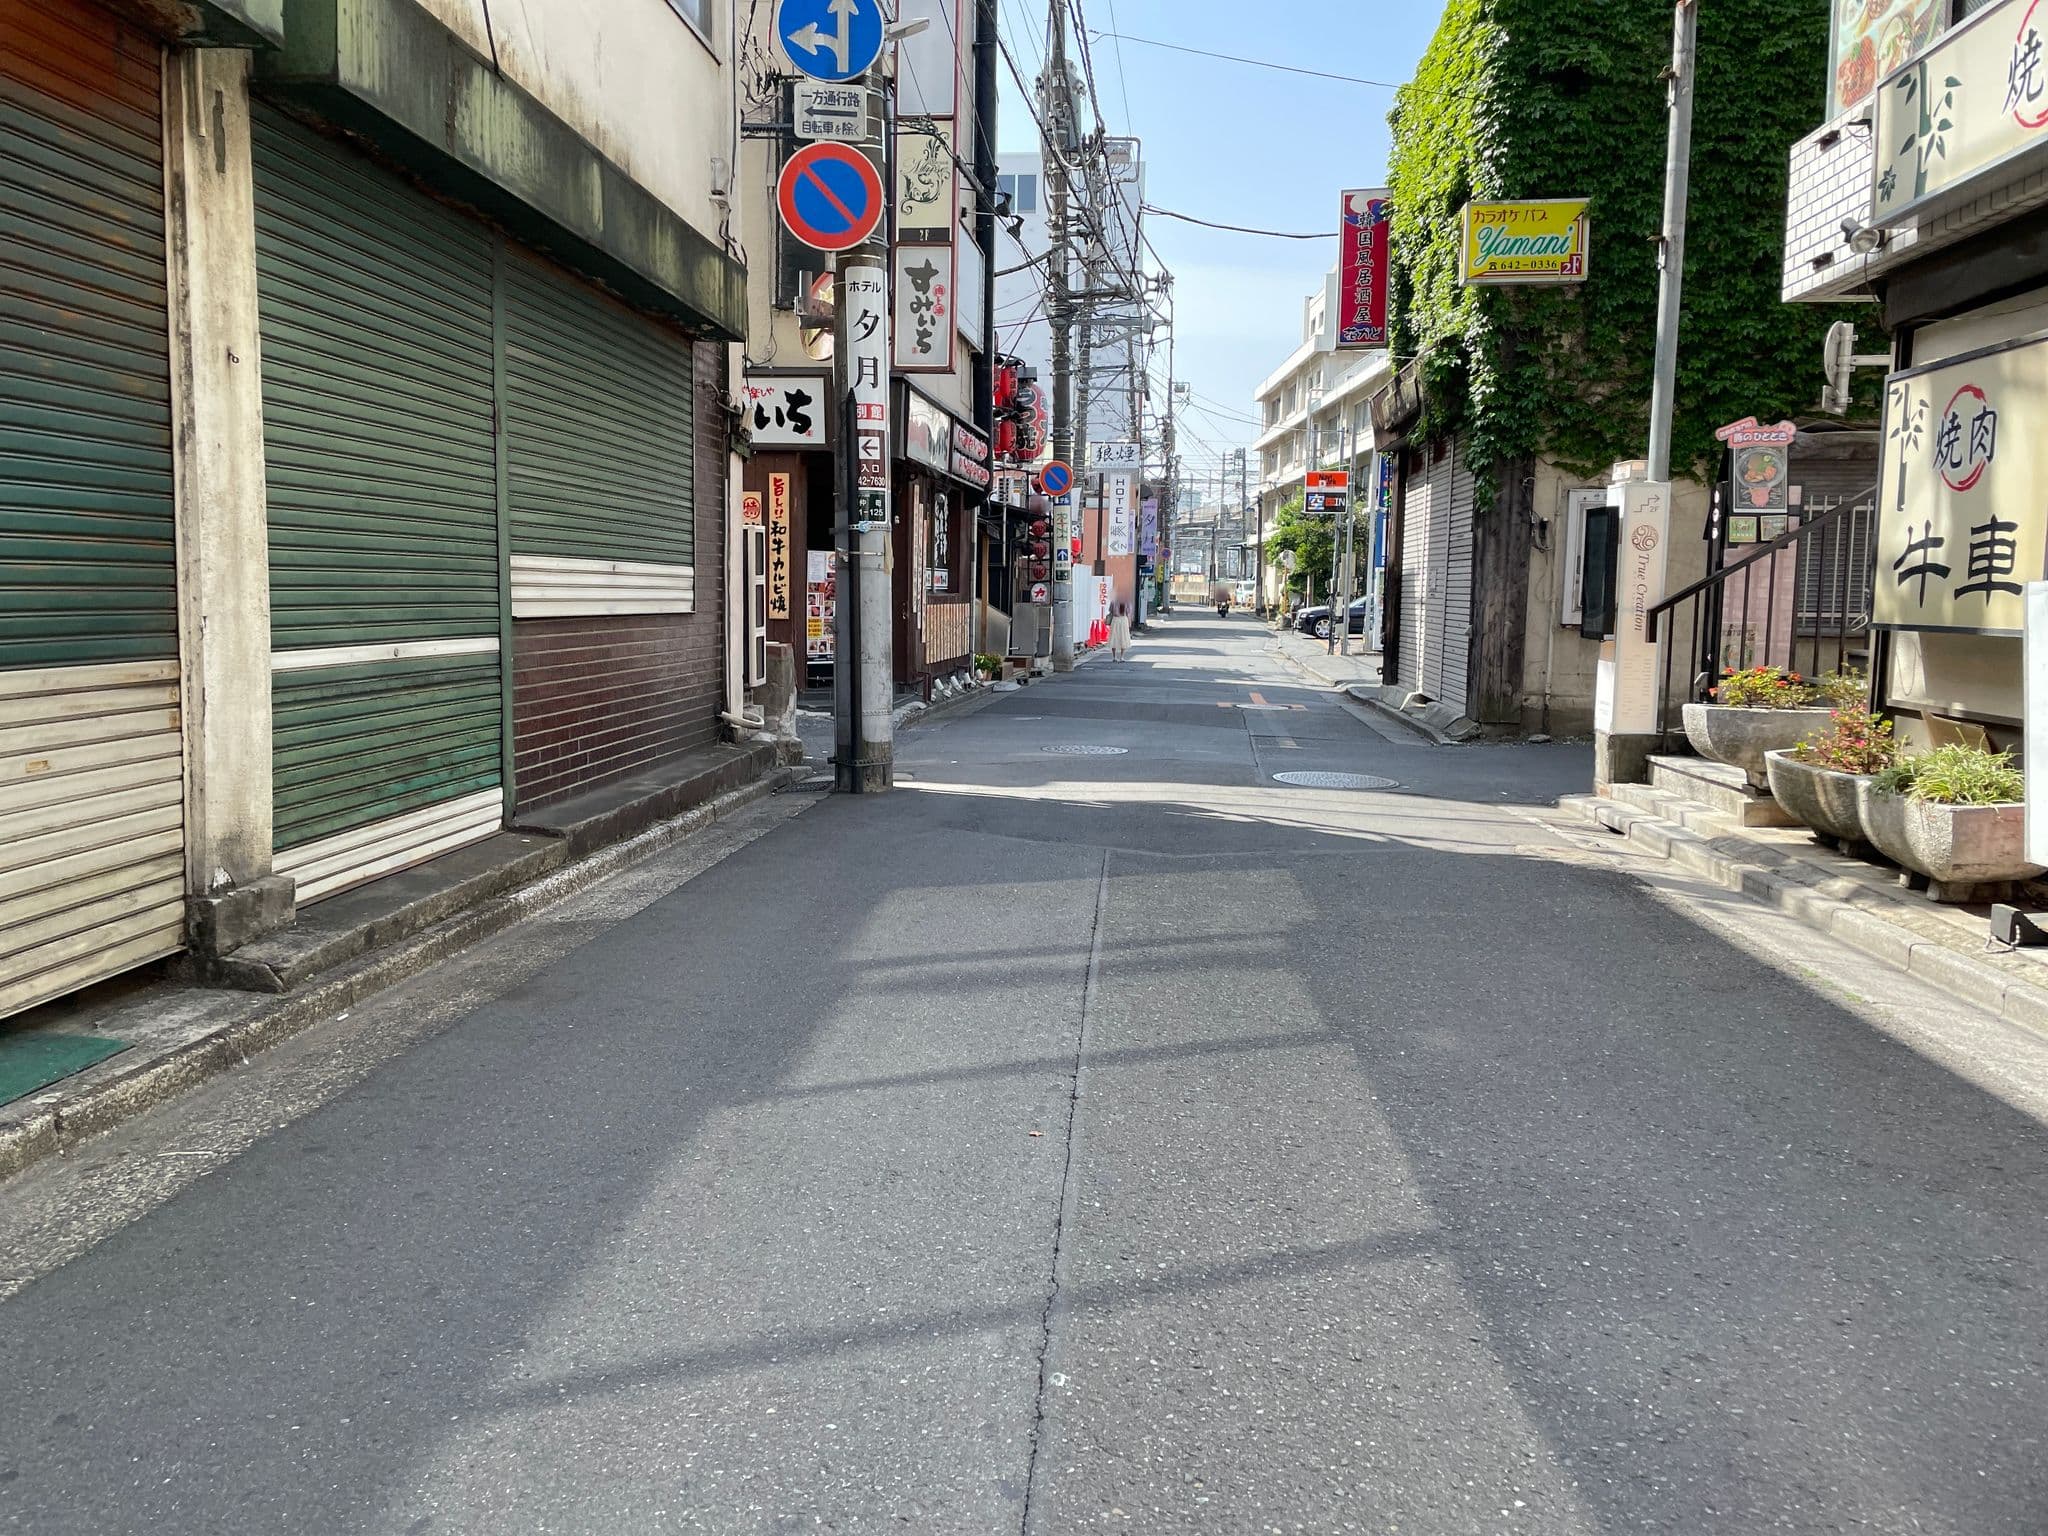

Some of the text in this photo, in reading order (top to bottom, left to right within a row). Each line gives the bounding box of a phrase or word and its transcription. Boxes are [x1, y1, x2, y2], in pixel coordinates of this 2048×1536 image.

[2002, 28, 2044, 114] 焼
[801, 90, 861, 107] 一方通行路
[802, 120, 860, 135] 自転車を除く
[1474, 209, 1548, 224] カラオケ パブ
[1474, 226, 1571, 267] Yamani
[1354, 212, 1374, 323] 韓国風居酒屋
[1500, 260, 1557, 269] 642-0336
[1561, 256, 1582, 274] 2F
[849, 281, 882, 292] ホテル
[904, 258, 939, 353] すみいち
[853, 308, 880, 388] 夕月
[857, 405, 883, 418] 別館
[1932, 404, 1998, 471] 焼肉
[861, 463, 880, 473] 入口
[1115, 478, 1125, 524] HOTEL
[1336, 497, 1346, 507] IN
[1649, 505, 1660, 513] 2F
[1892, 513, 2023, 609] 牛車
[1633, 553, 1650, 632] True Creation
